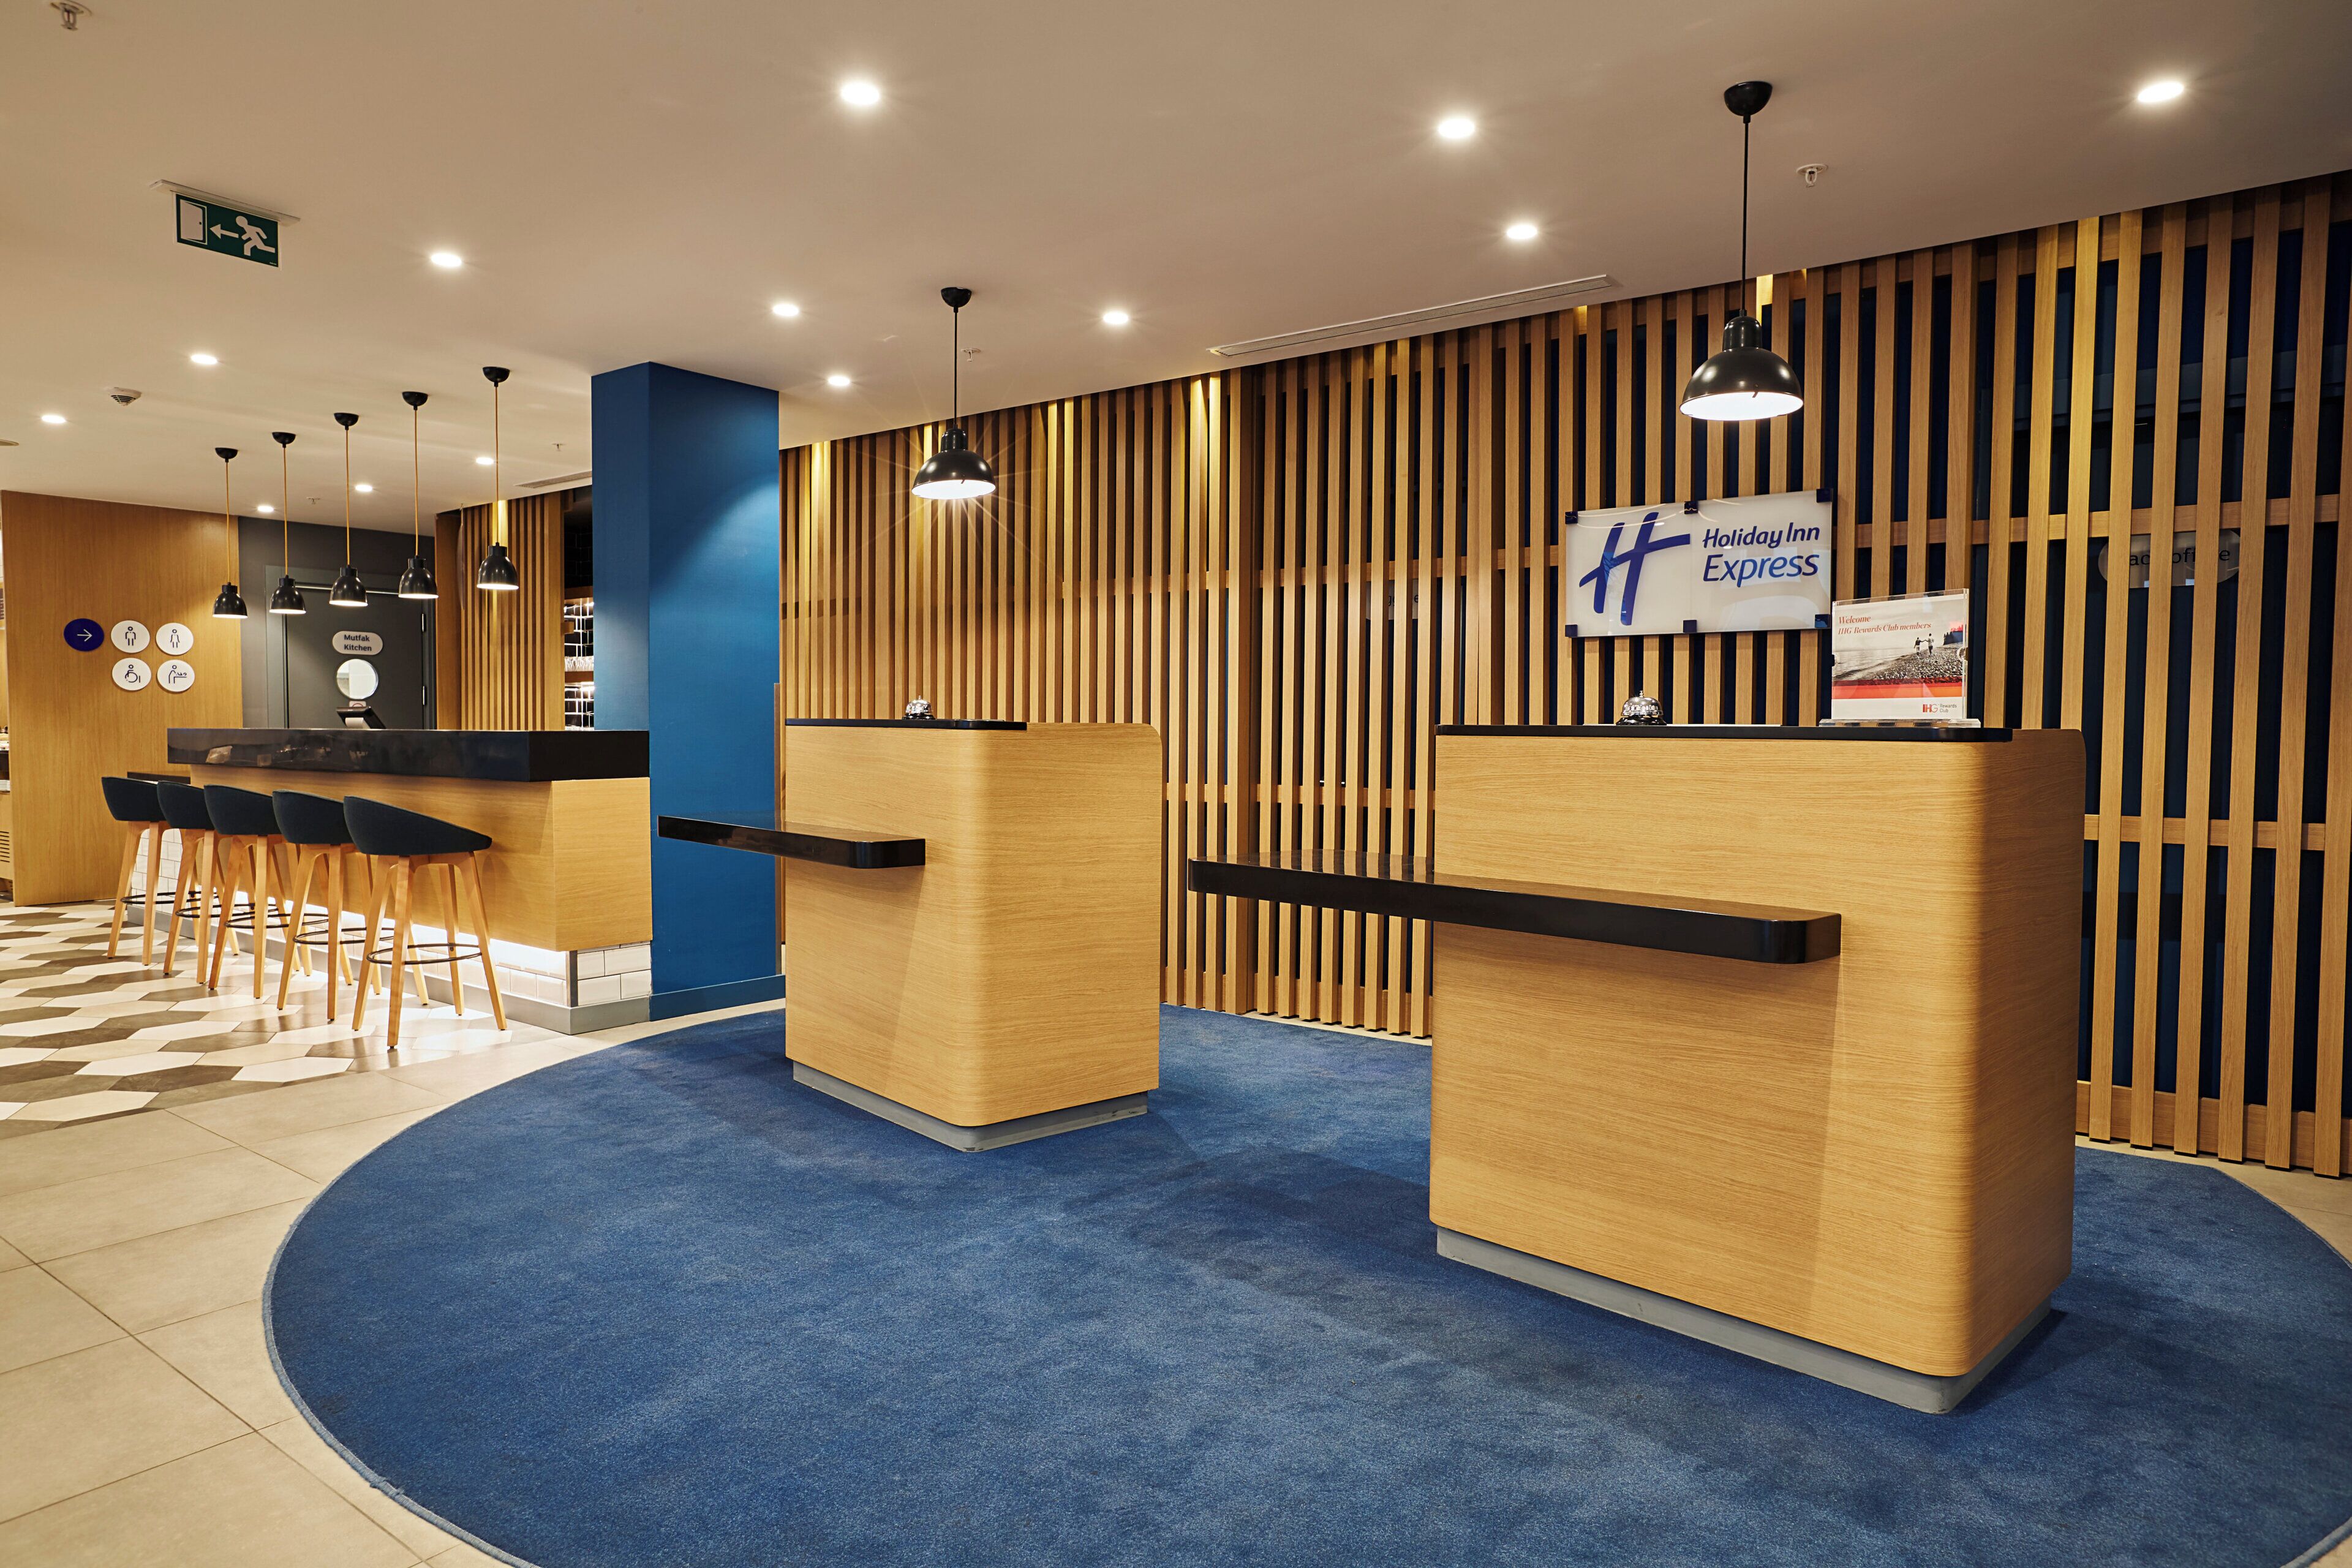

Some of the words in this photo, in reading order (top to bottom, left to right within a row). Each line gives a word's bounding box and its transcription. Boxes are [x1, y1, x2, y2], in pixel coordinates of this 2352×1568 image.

[1702, 526, 1783, 549] Holiday
[1786, 522, 1820, 543] Inn
[1703, 554, 1820, 587] Express
[1839, 616, 1871, 624] Welcome
[1854, 625, 1882, 634] Rewards
[1883, 624, 1899, 632] Club
[1899, 622, 1931, 631] members
[1923, 704, 1938, 712] IHG
